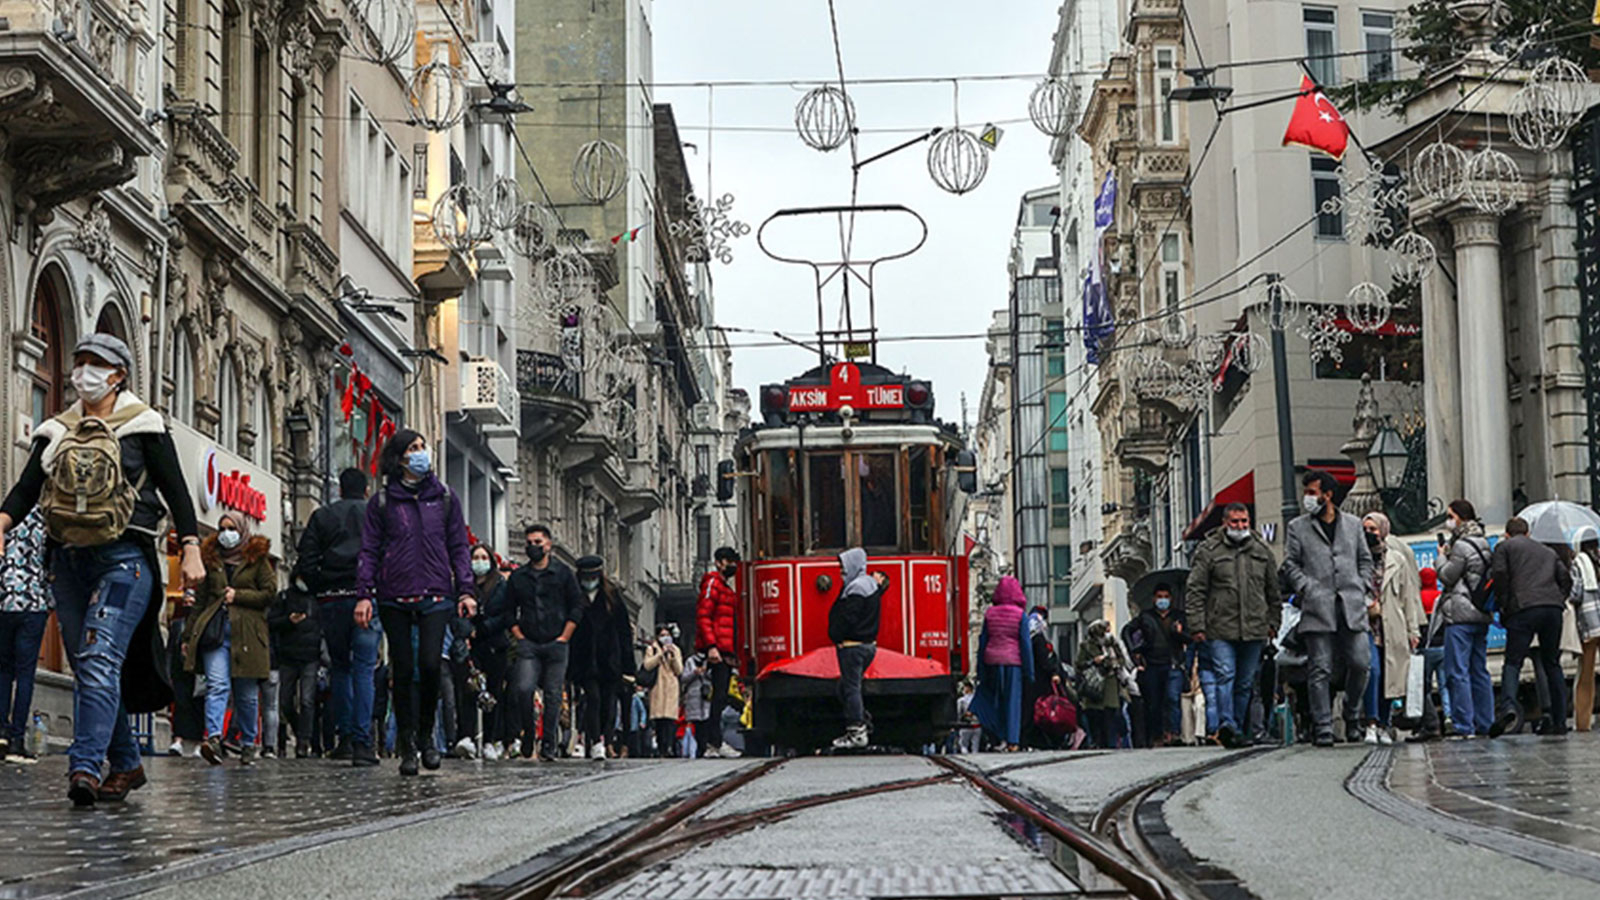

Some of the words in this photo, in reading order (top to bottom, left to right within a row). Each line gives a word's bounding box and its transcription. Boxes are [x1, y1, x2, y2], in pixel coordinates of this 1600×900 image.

[839, 365, 849, 383] 4
[789, 388, 828, 407] AKSİM
[218, 469, 267, 523] vodafone
[761, 579, 780, 599] 115
[923, 574, 942, 593] 115
